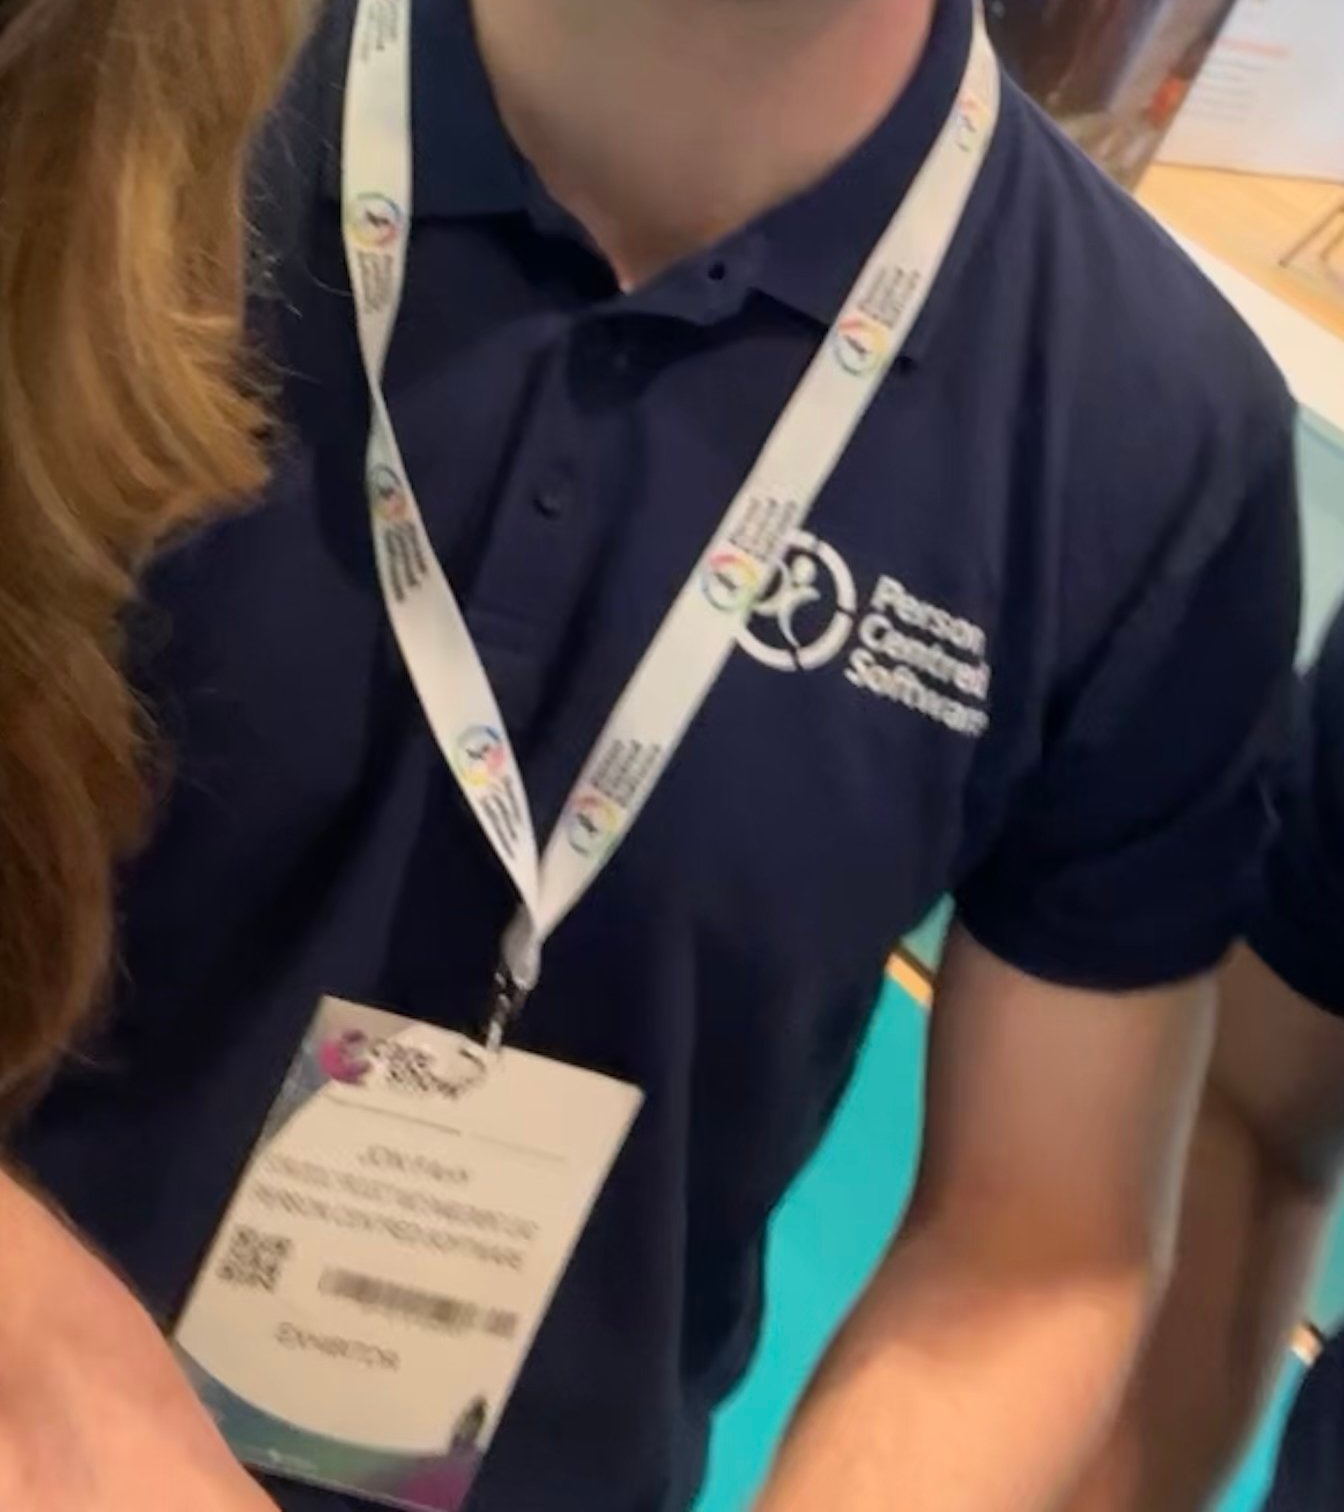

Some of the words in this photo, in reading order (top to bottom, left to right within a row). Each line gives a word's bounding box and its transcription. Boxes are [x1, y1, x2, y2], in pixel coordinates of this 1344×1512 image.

[859, 612, 992, 701] Centred
[870, 573, 987, 659] Person
[843, 647, 990, 738] Software
